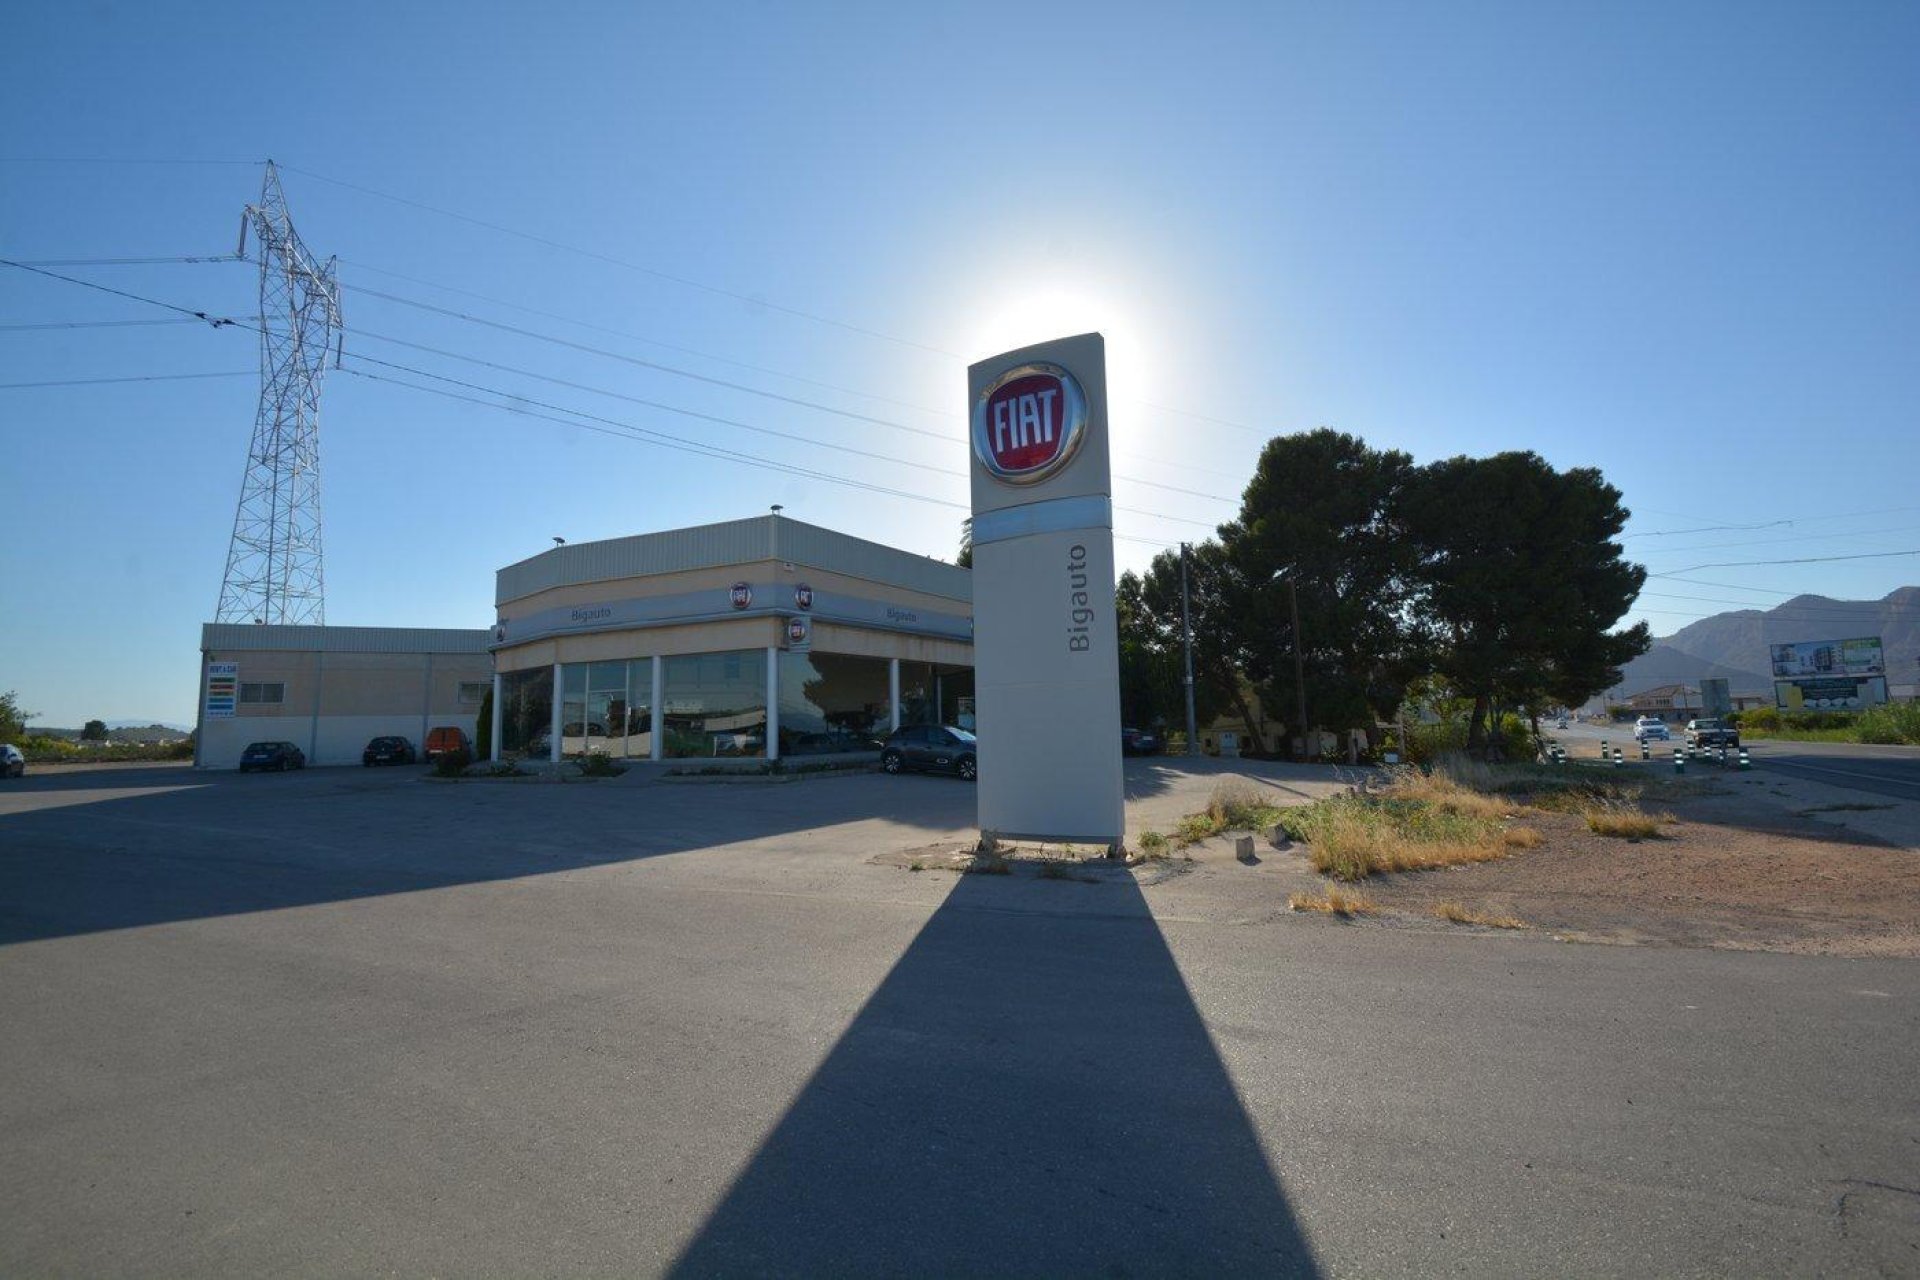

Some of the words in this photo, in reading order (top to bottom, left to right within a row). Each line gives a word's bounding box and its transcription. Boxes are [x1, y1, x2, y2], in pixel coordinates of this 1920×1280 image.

[994, 388, 1057, 453] FIAT
[571, 607, 611, 622] Bigauto
[1067, 544, 1094, 651] Bigauto
